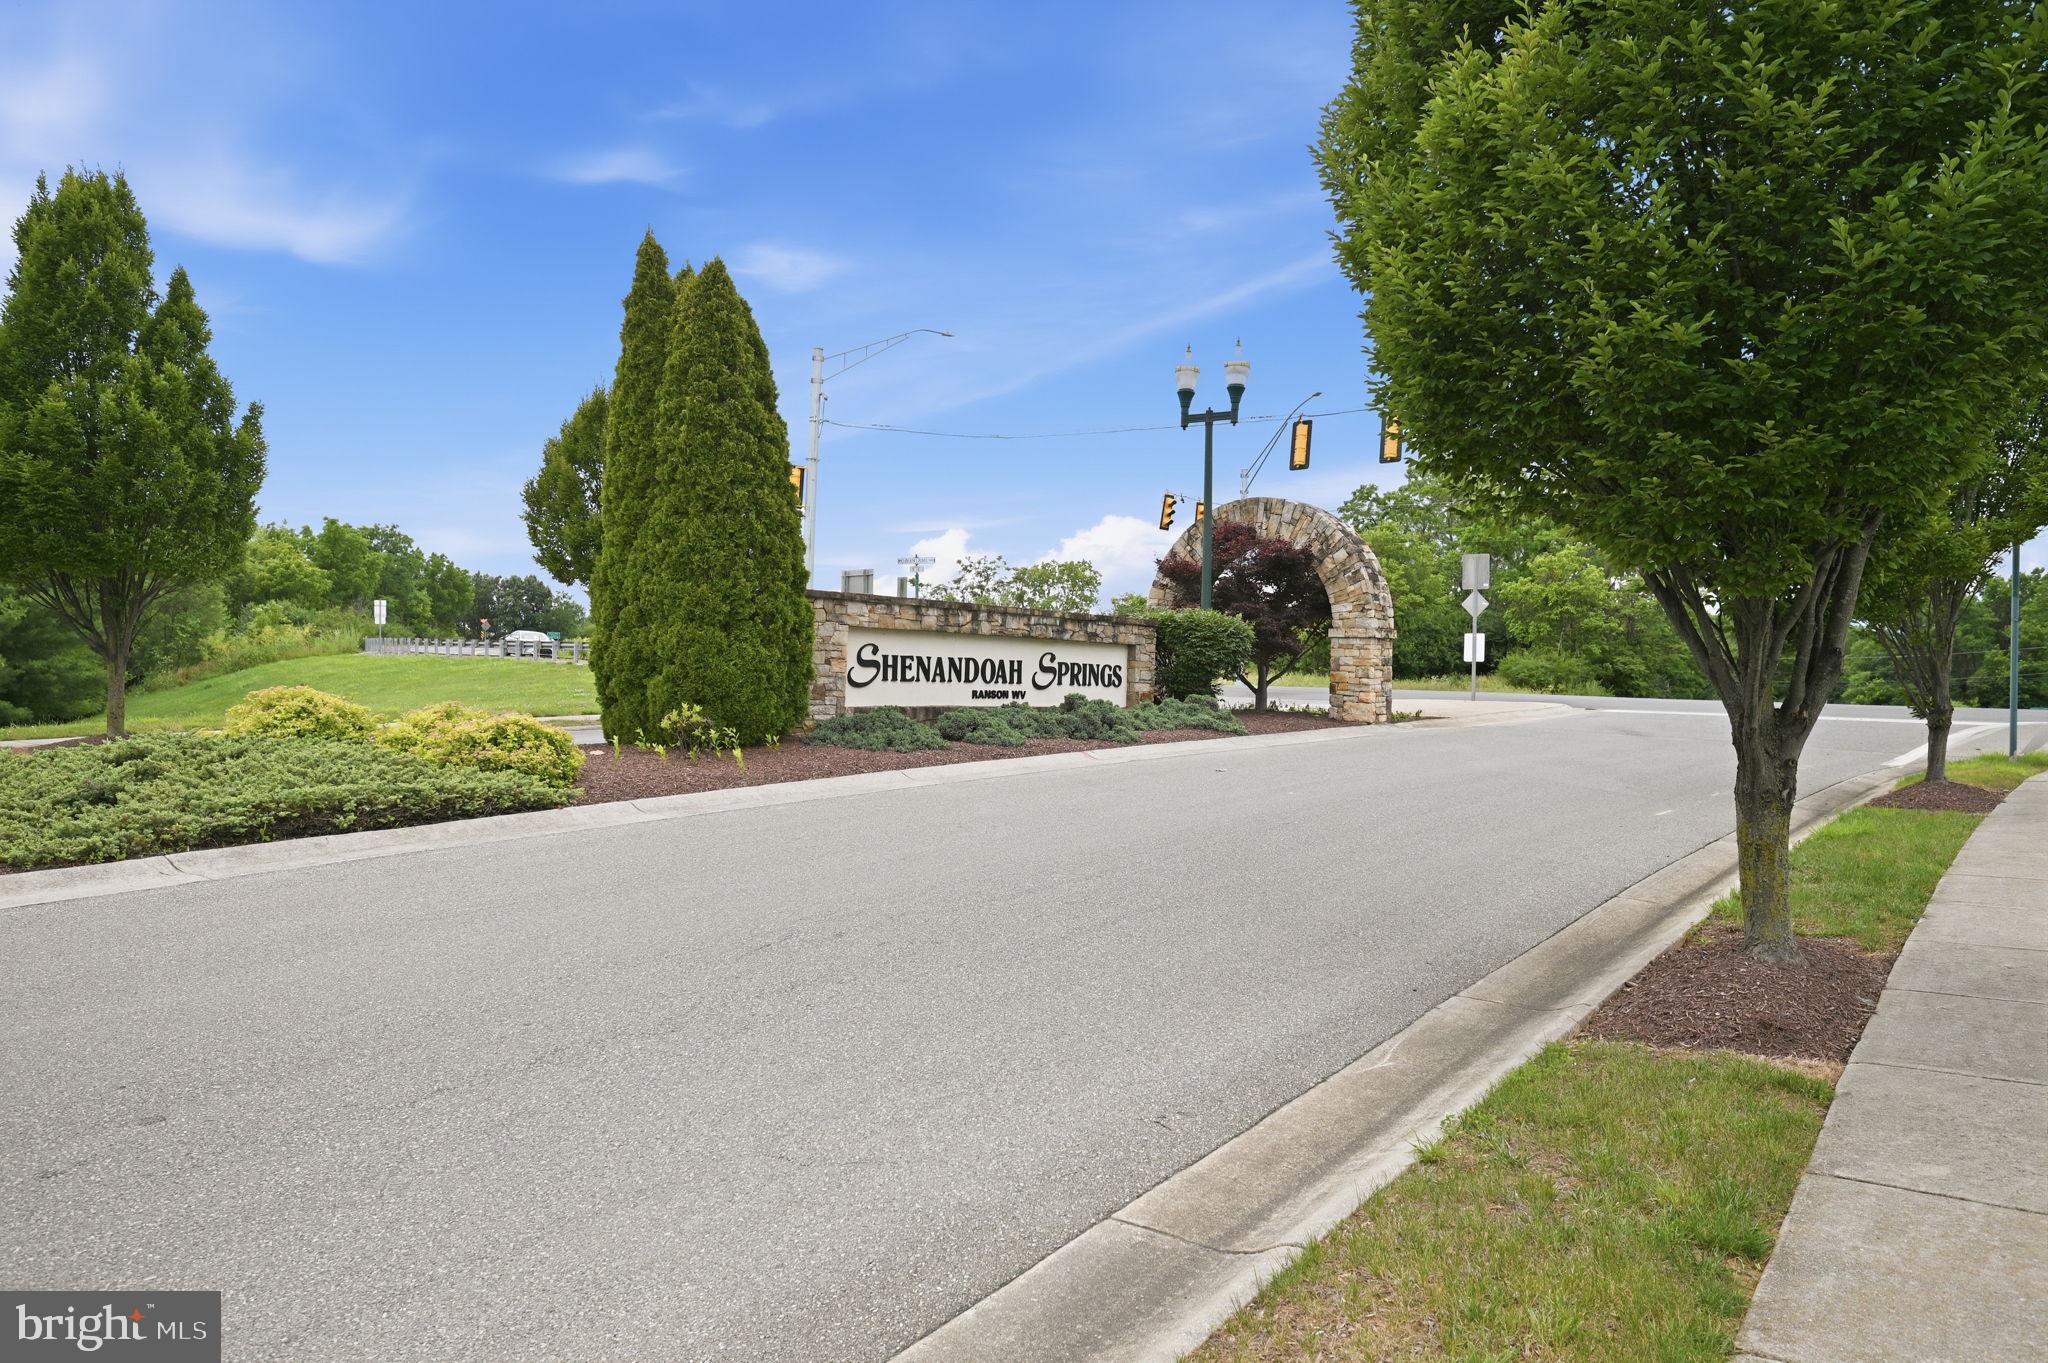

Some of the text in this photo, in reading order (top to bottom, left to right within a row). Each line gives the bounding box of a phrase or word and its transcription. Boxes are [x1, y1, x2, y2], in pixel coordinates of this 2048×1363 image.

[847, 643, 1122, 690] SHENANDOAH SPRINGS
[971, 690, 1026, 700] RANSON WV
